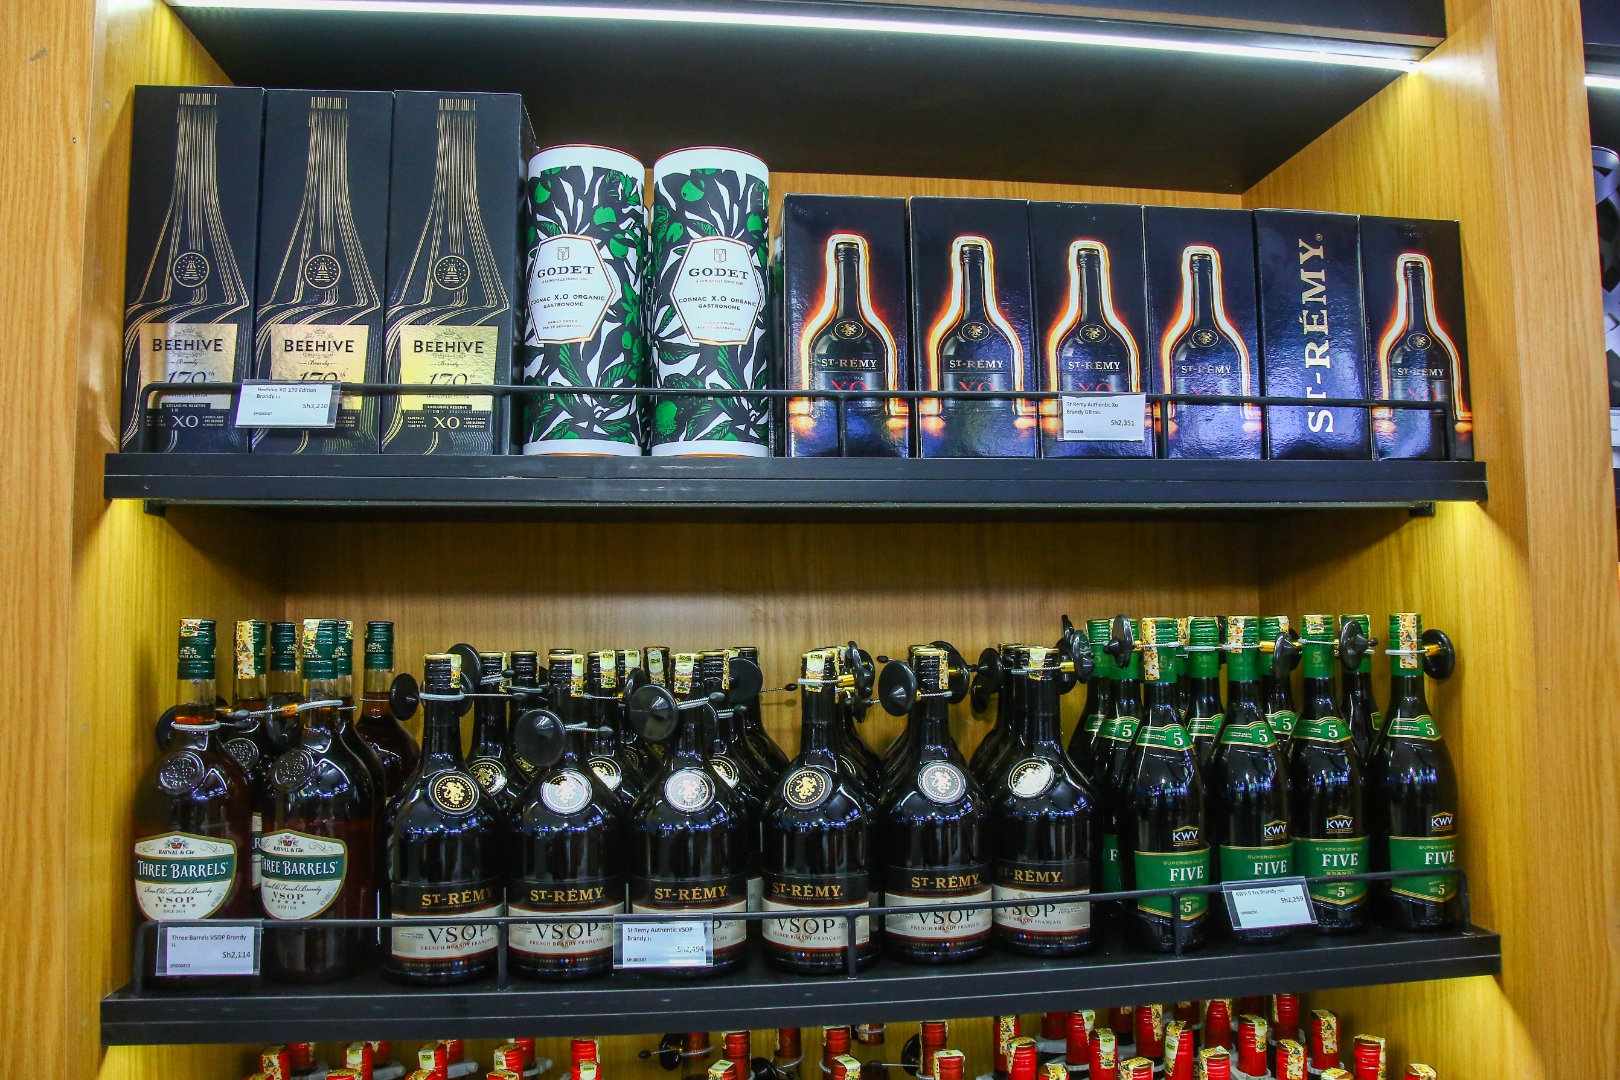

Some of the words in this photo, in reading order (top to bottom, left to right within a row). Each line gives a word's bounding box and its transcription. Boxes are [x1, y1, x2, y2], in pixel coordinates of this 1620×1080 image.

[538, 266, 594, 278] GODET
[689, 268, 749, 280] GODET
[531, 297, 551, 306] COGNAC
[730, 298, 757, 307] ORGANIC
[152, 338, 223, 351] BEEHIVE
[284, 339, 354, 353] BEEHIVE
[414, 340, 484, 354] BEEHIVE
[821, 358, 877, 368] ST-RÉMY
[949, 360, 1004, 368] ST-RÉMY
[1068, 361, 1120, 370] ST-RÉMY
[172, 415, 198, 428] XO
[433, 416, 460, 429] XO
[1122, 724, 1132, 736] 5
[1282, 718, 1292, 730] 5
[1425, 723, 1435, 736] 5
[1259, 730, 1268, 743] 5
[1329, 725, 1338, 738] 5
[1174, 732, 1183, 746] 5
[1326, 820, 1352, 829] KWV
[1431, 816, 1453, 826] KWV
[1173, 831, 1198, 841] KWV
[1264, 825, 1286, 836] KWV
[1322, 853, 1358, 866] FIVE
[1424, 850, 1455, 865] FIVE
[138, 860, 168, 877] THREE
[170, 862, 227, 878] BARRELS
[283, 860, 336, 875] BARRELS
[1170, 865, 1204, 882] FIVE
[1253, 860, 1287, 875] FIVE
[911, 874, 979, 889] ST-RÉMY
[273, 891, 304, 900] VSOP
[530, 887, 603, 902] ST-RÉMY
[655, 885, 727, 900] ST-RÉMY
[772, 882, 841, 897] ST-RÉMY
[1338, 887, 1346, 897] 5
[1439, 884, 1445, 895] 5
[422, 887, 492, 906] ST-RÉMY
[1000, 898, 1056, 917] VSOP
[1184, 901, 1192, 912] 5
[918, 910, 975, 924] VSOP
[536, 922, 599, 939] VSOP
[778, 918, 835, 934] VSOP
[428, 924, 488, 944] VSOP
[222, 951, 250, 959] Sh2,114
